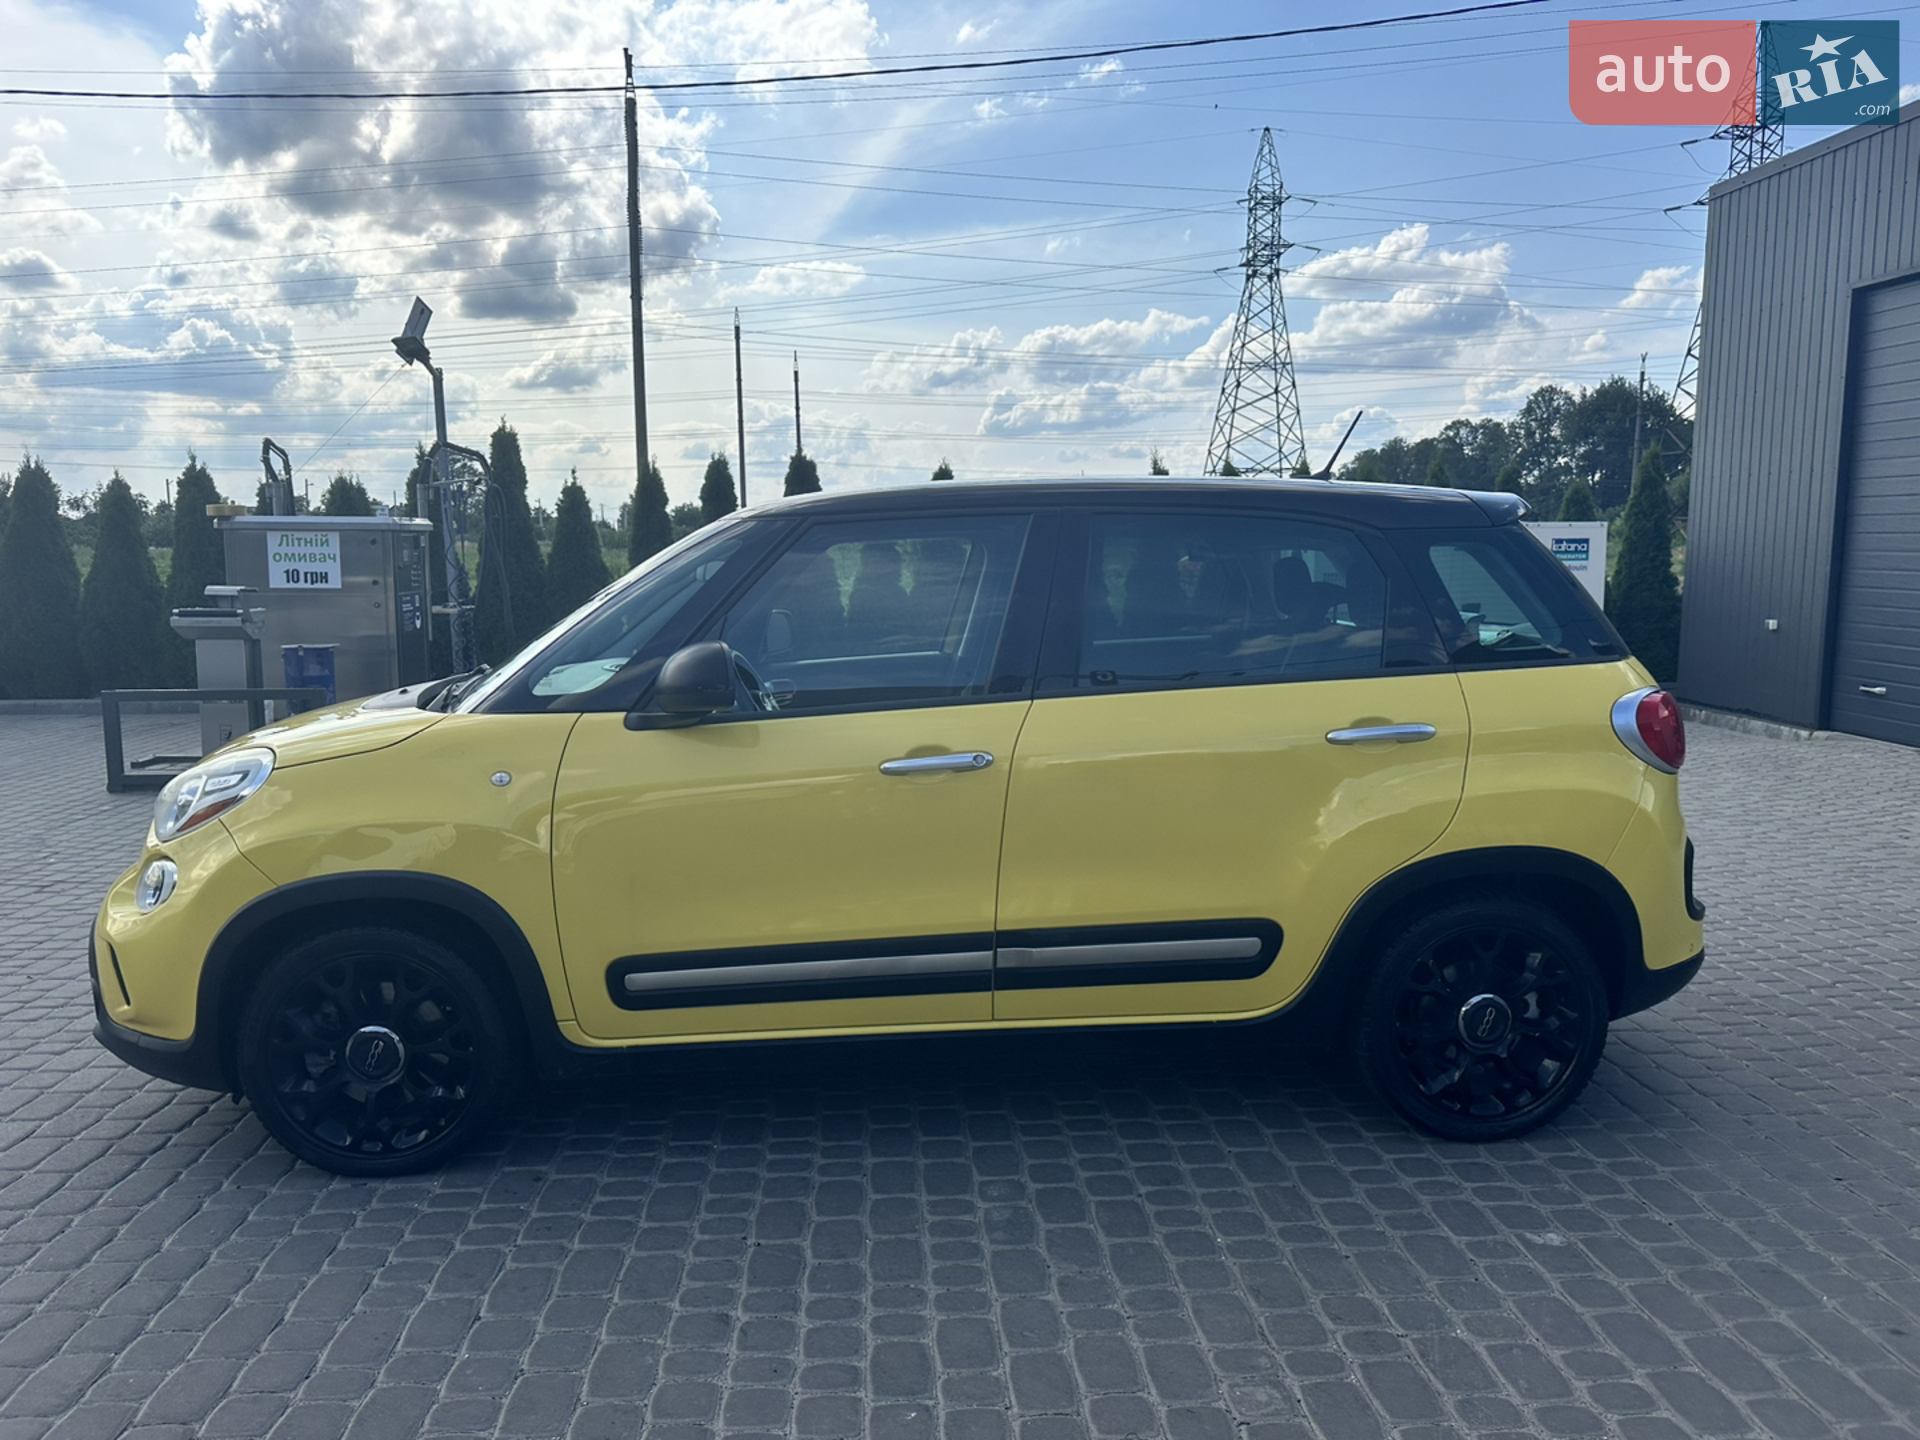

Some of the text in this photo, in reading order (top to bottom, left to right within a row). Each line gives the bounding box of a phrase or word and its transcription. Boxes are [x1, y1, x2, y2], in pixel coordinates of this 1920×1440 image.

[278, 533, 330, 548] Літній
[1552, 539, 1588, 551] katana
[272, 552, 337, 563] омивач
[283, 568, 329, 585] 10 грн
